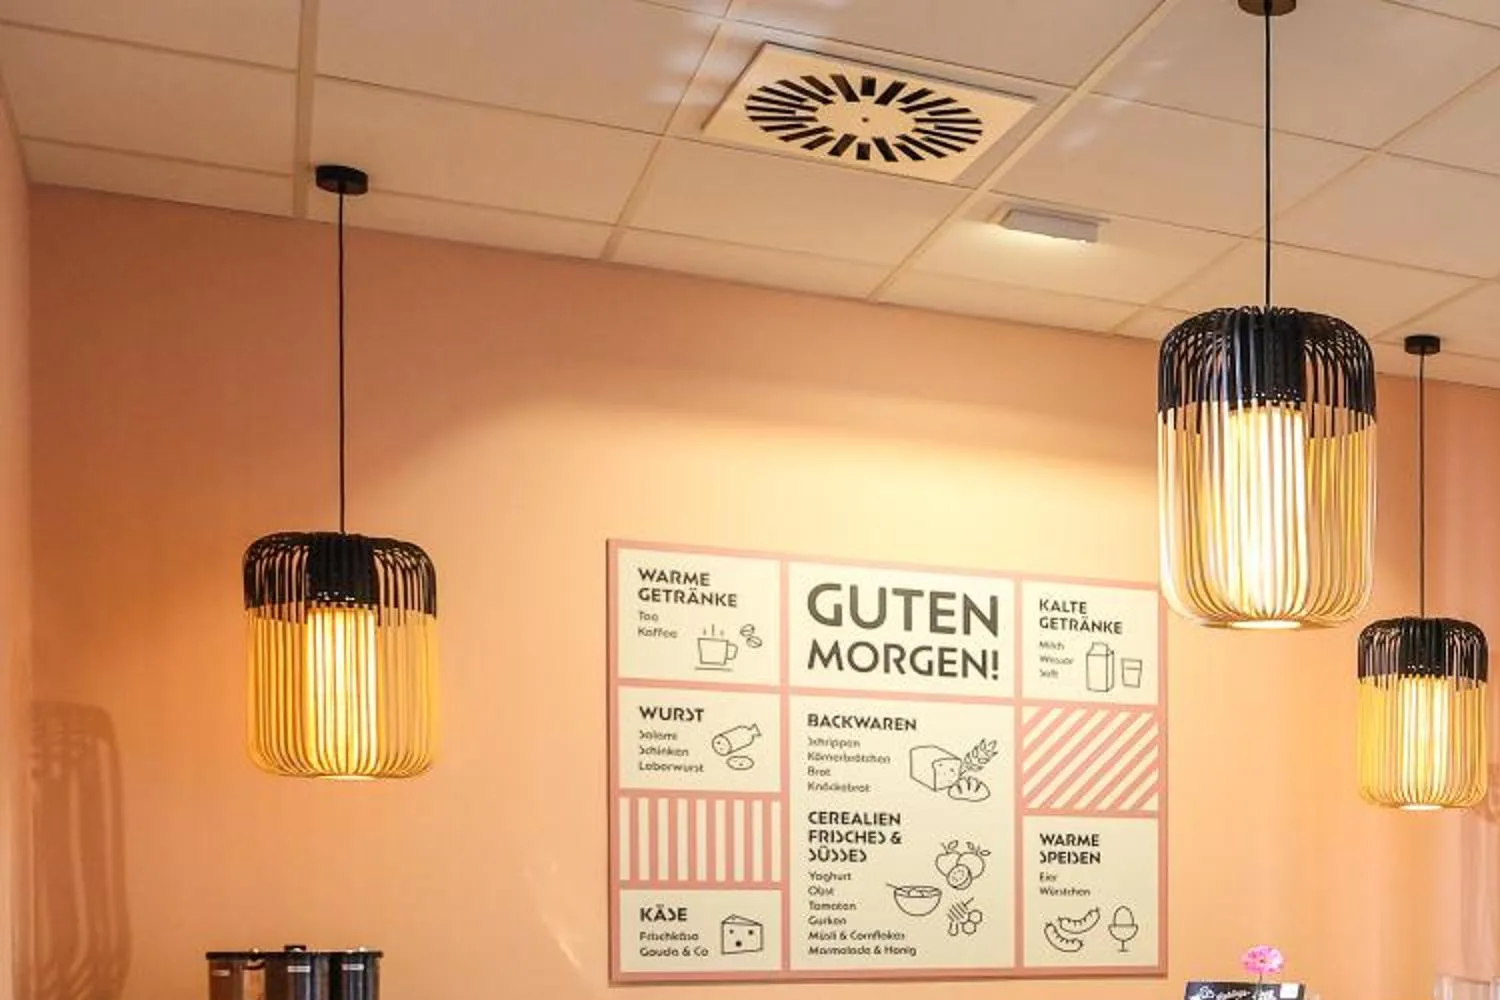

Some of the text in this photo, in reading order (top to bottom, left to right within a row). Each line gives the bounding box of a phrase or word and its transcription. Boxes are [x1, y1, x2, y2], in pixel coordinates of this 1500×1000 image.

[637, 567, 711, 587] WARME
[637, 587, 737, 609] GETRÄNKE
[806, 582, 999, 638] GUTEN
[1039, 598, 1088, 615] KALTE
[637, 626, 678, 639] Kaffee
[1039, 615, 1123, 635] GETRÄNKE
[807, 638, 999, 681] MORGEN!
[638, 705, 705, 723] WURST
[807, 713, 917, 732] BACKWAREN
[638, 729, 678, 741] Salami
[637, 760, 705, 774] Leberwurst
[806, 765, 832, 777] Brot
[807, 810, 901, 827] CEREALIEN
[807, 829, 902, 845] FRISCHES &
[1039, 832, 1100, 848] WARME
[808, 844, 868, 863] SÜSSES
[1039, 850, 1101, 865] SPEISEN
[807, 870, 852, 883] Yoghurt
[639, 903, 688, 923] KÄSE
[808, 899, 857, 912] Tomaten
[807, 914, 848, 927] Gurken
[839, 930, 848, 941] &
[639, 946, 680, 958] Gouda
[681, 945, 692, 957] &
[873, 944, 882, 955] &
[883, 945, 917, 958] Honig
